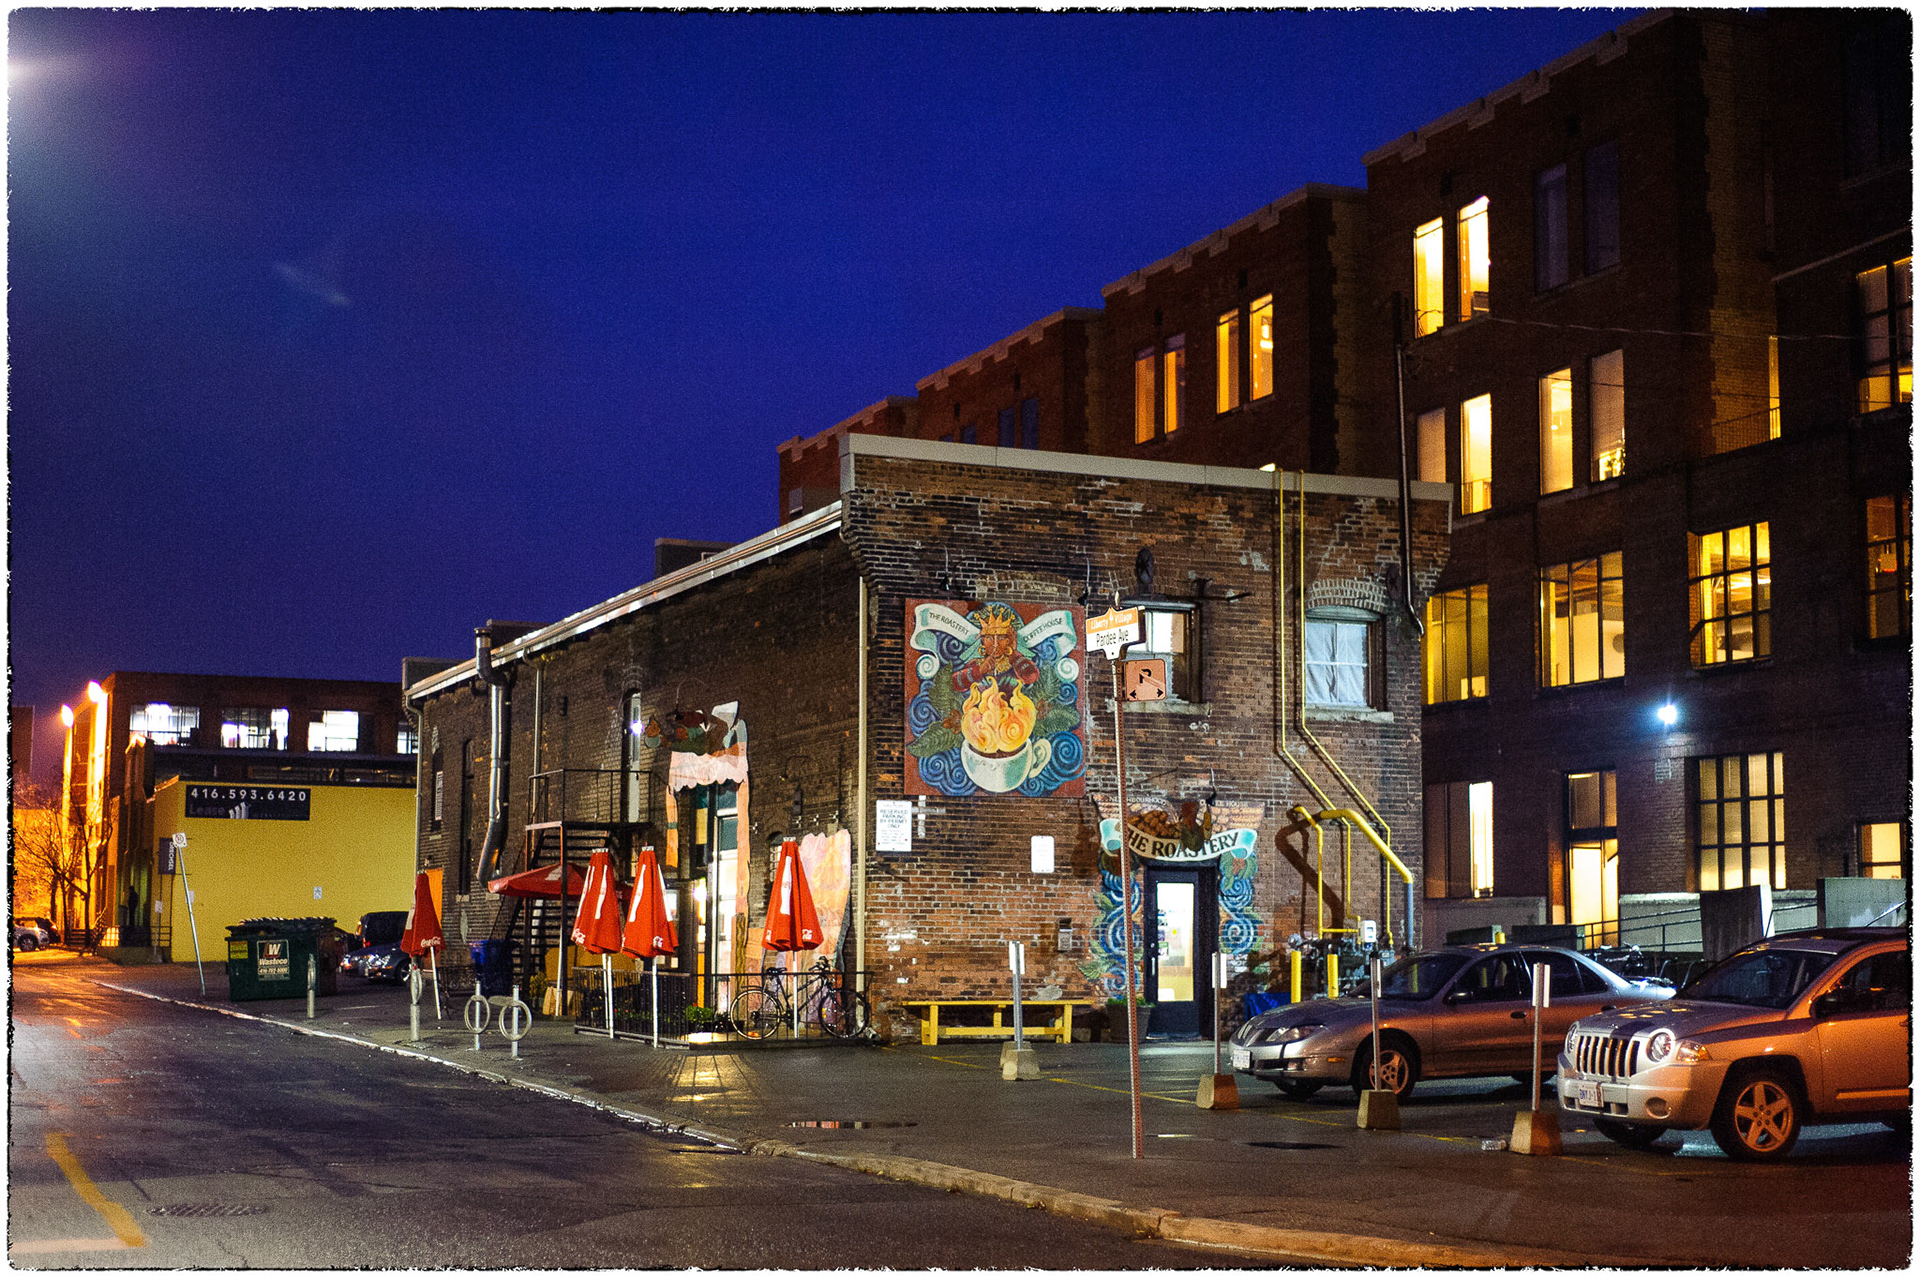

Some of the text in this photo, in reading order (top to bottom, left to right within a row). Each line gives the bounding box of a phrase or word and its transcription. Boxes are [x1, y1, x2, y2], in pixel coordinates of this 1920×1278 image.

[929, 612, 940, 621] THE
[1090, 612, 1133, 630] Liberty Village
[1096, 628, 1129, 648] Pardee Ave
[191, 787, 307, 801] 416.593.6420
[188, 803, 226, 816] Lease
[1128, 830, 1148, 855] HE
